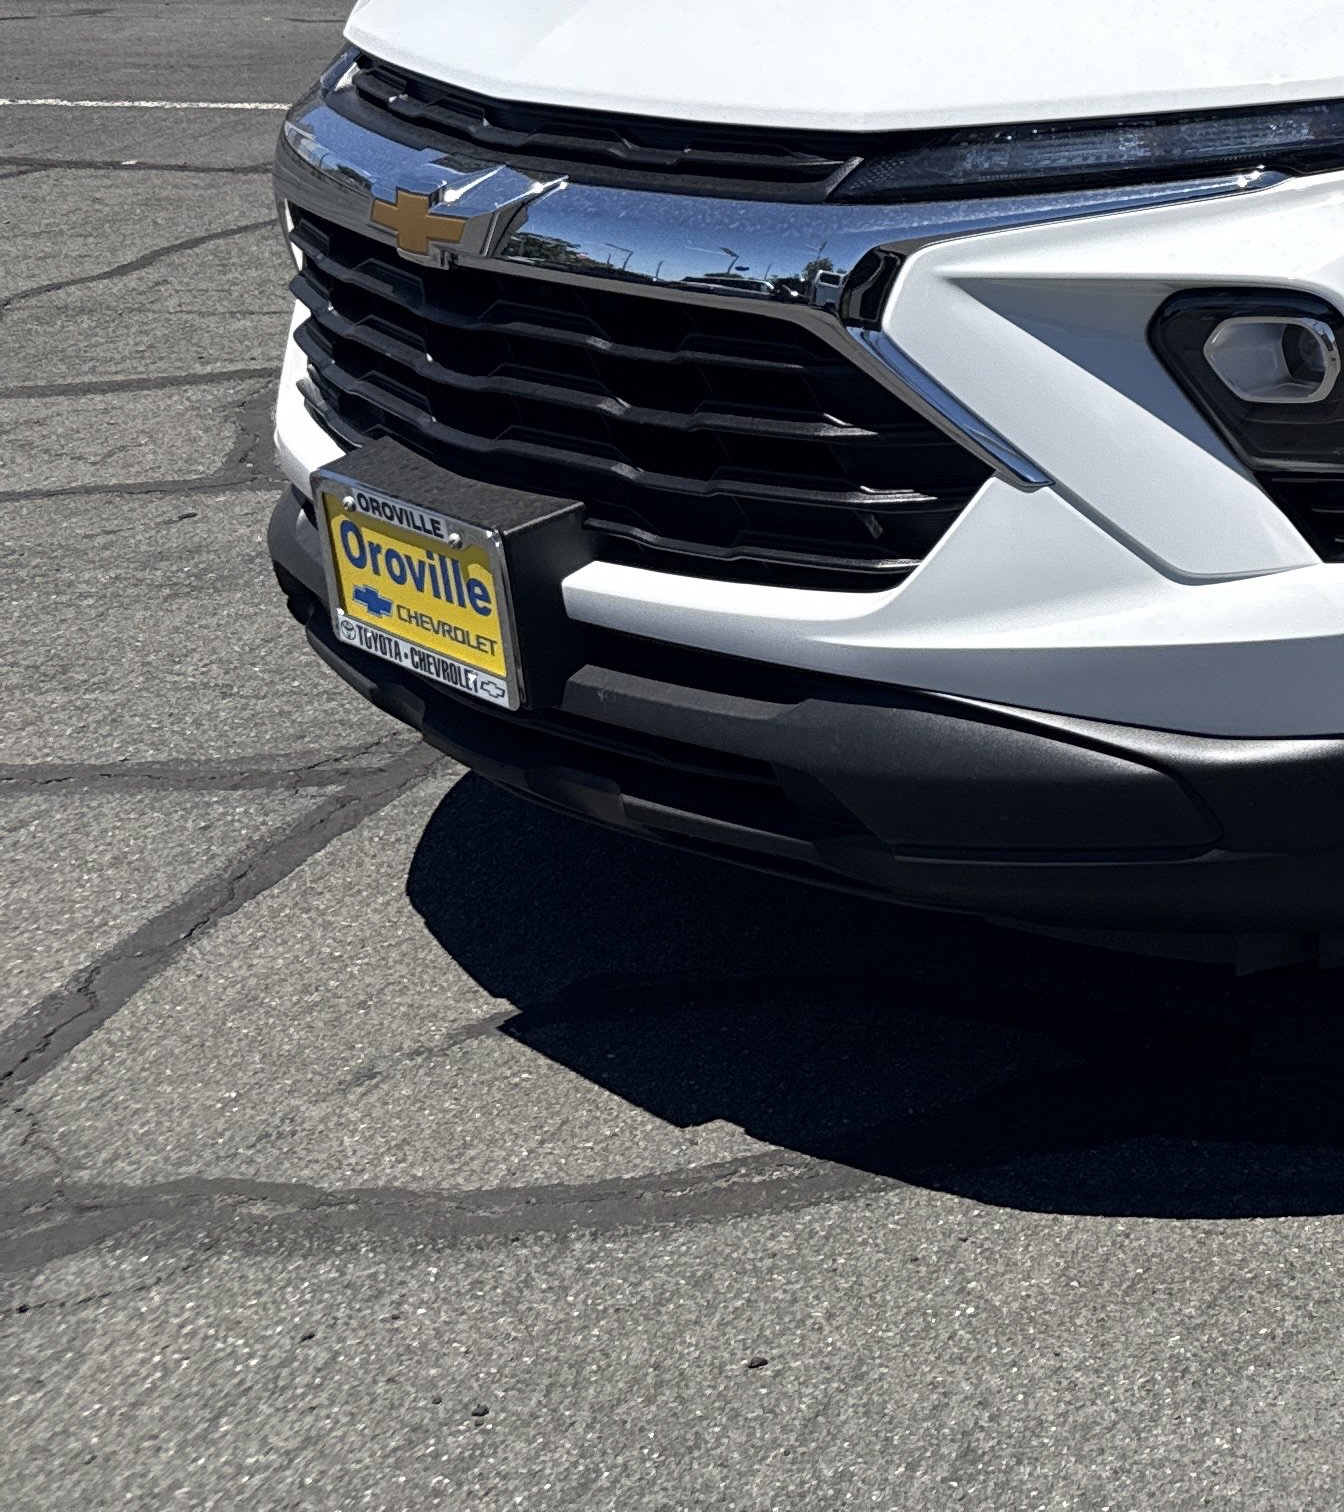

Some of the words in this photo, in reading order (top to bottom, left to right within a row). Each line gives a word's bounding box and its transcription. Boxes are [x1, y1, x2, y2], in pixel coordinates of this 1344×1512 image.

[356, 492, 446, 539] OROVILLE
[340, 519, 493, 617] Oroville
[355, 624, 402, 663] TOYOTA
[396, 604, 498, 657] CHEVROLET
